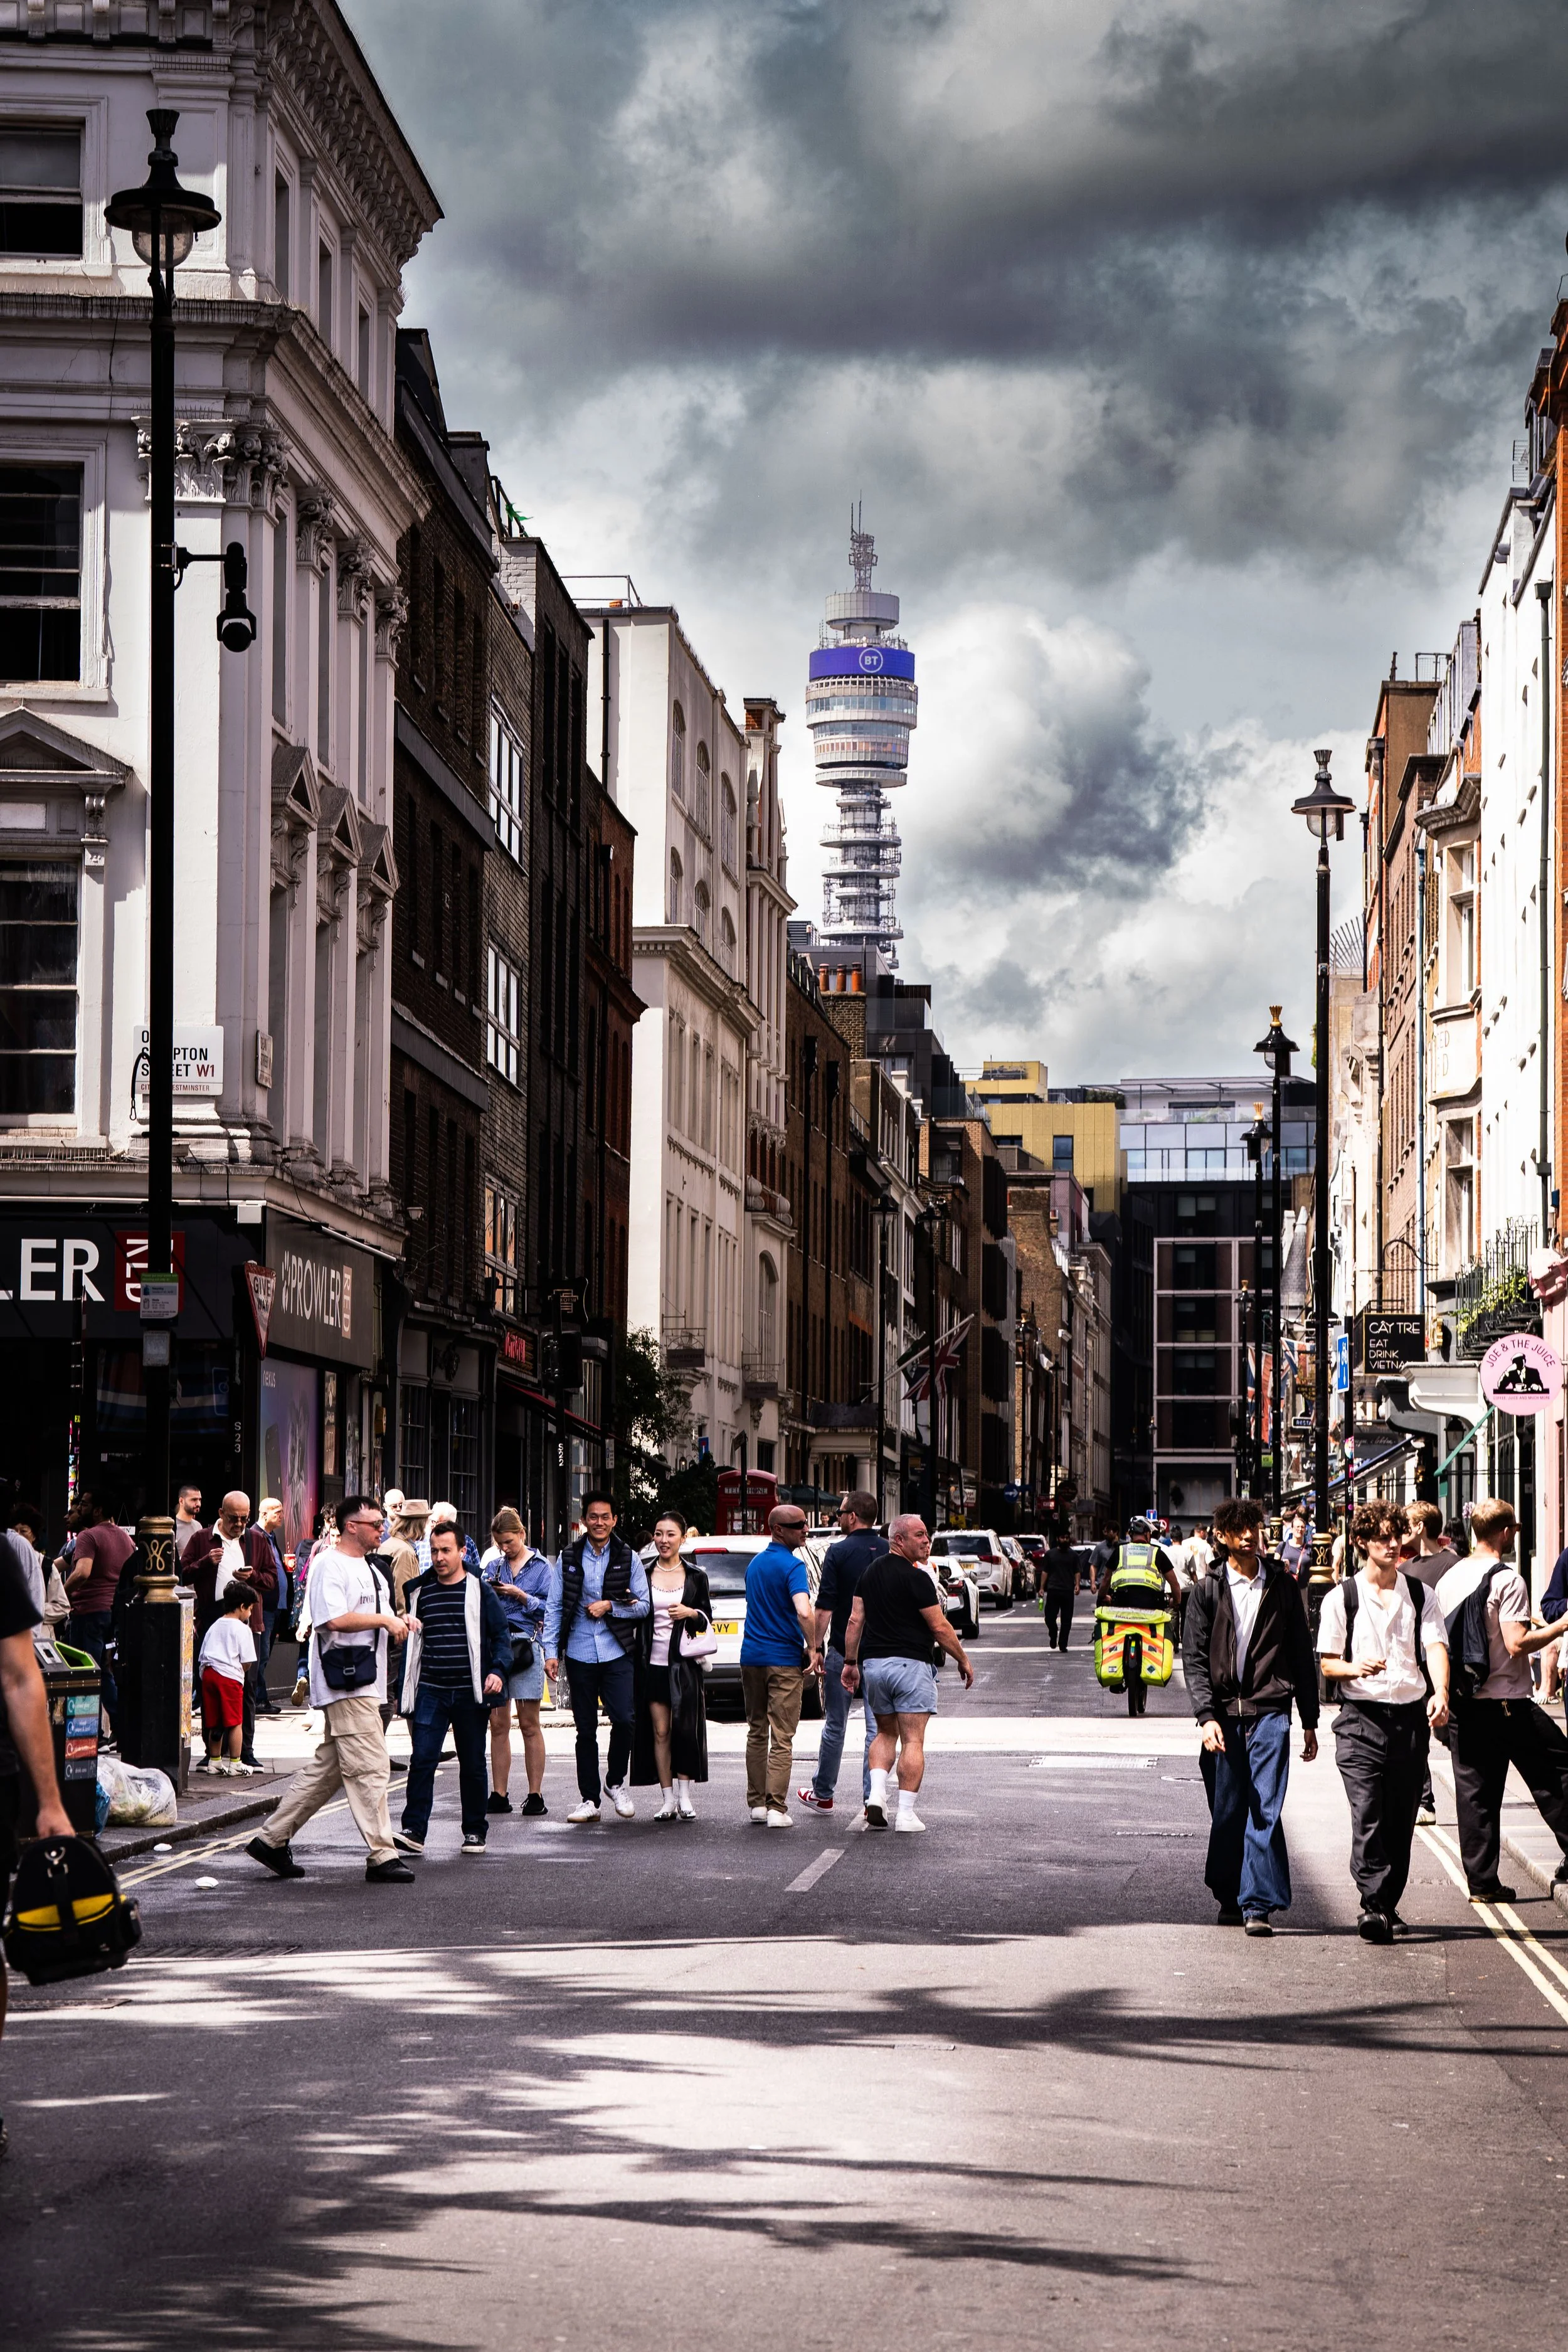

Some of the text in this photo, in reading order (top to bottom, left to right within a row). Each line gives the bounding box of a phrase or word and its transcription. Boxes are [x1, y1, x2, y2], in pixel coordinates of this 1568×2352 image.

[864, 655, 878, 665] BT
[196, 1064, 215, 1077] W1
[0, 1239, 105, 1301] ER
[253, 1276, 272, 1296] GIVE
[290, 1254, 341, 1328] PROWLER
[257, 1299, 269, 1312] WAY
[1369, 1320, 1420, 1334] CÂY TRE
[1369, 1339, 1389, 1348] EAT
[1369, 1350, 1399, 1359] DRINK
[1486, 1339, 1555, 1367] JOE & THE JUICE
[1370, 1360, 1410, 1369] VIETNA
[262, 1370, 276, 1388] nexus
[150, 1809, 163, 1820] WASTE
